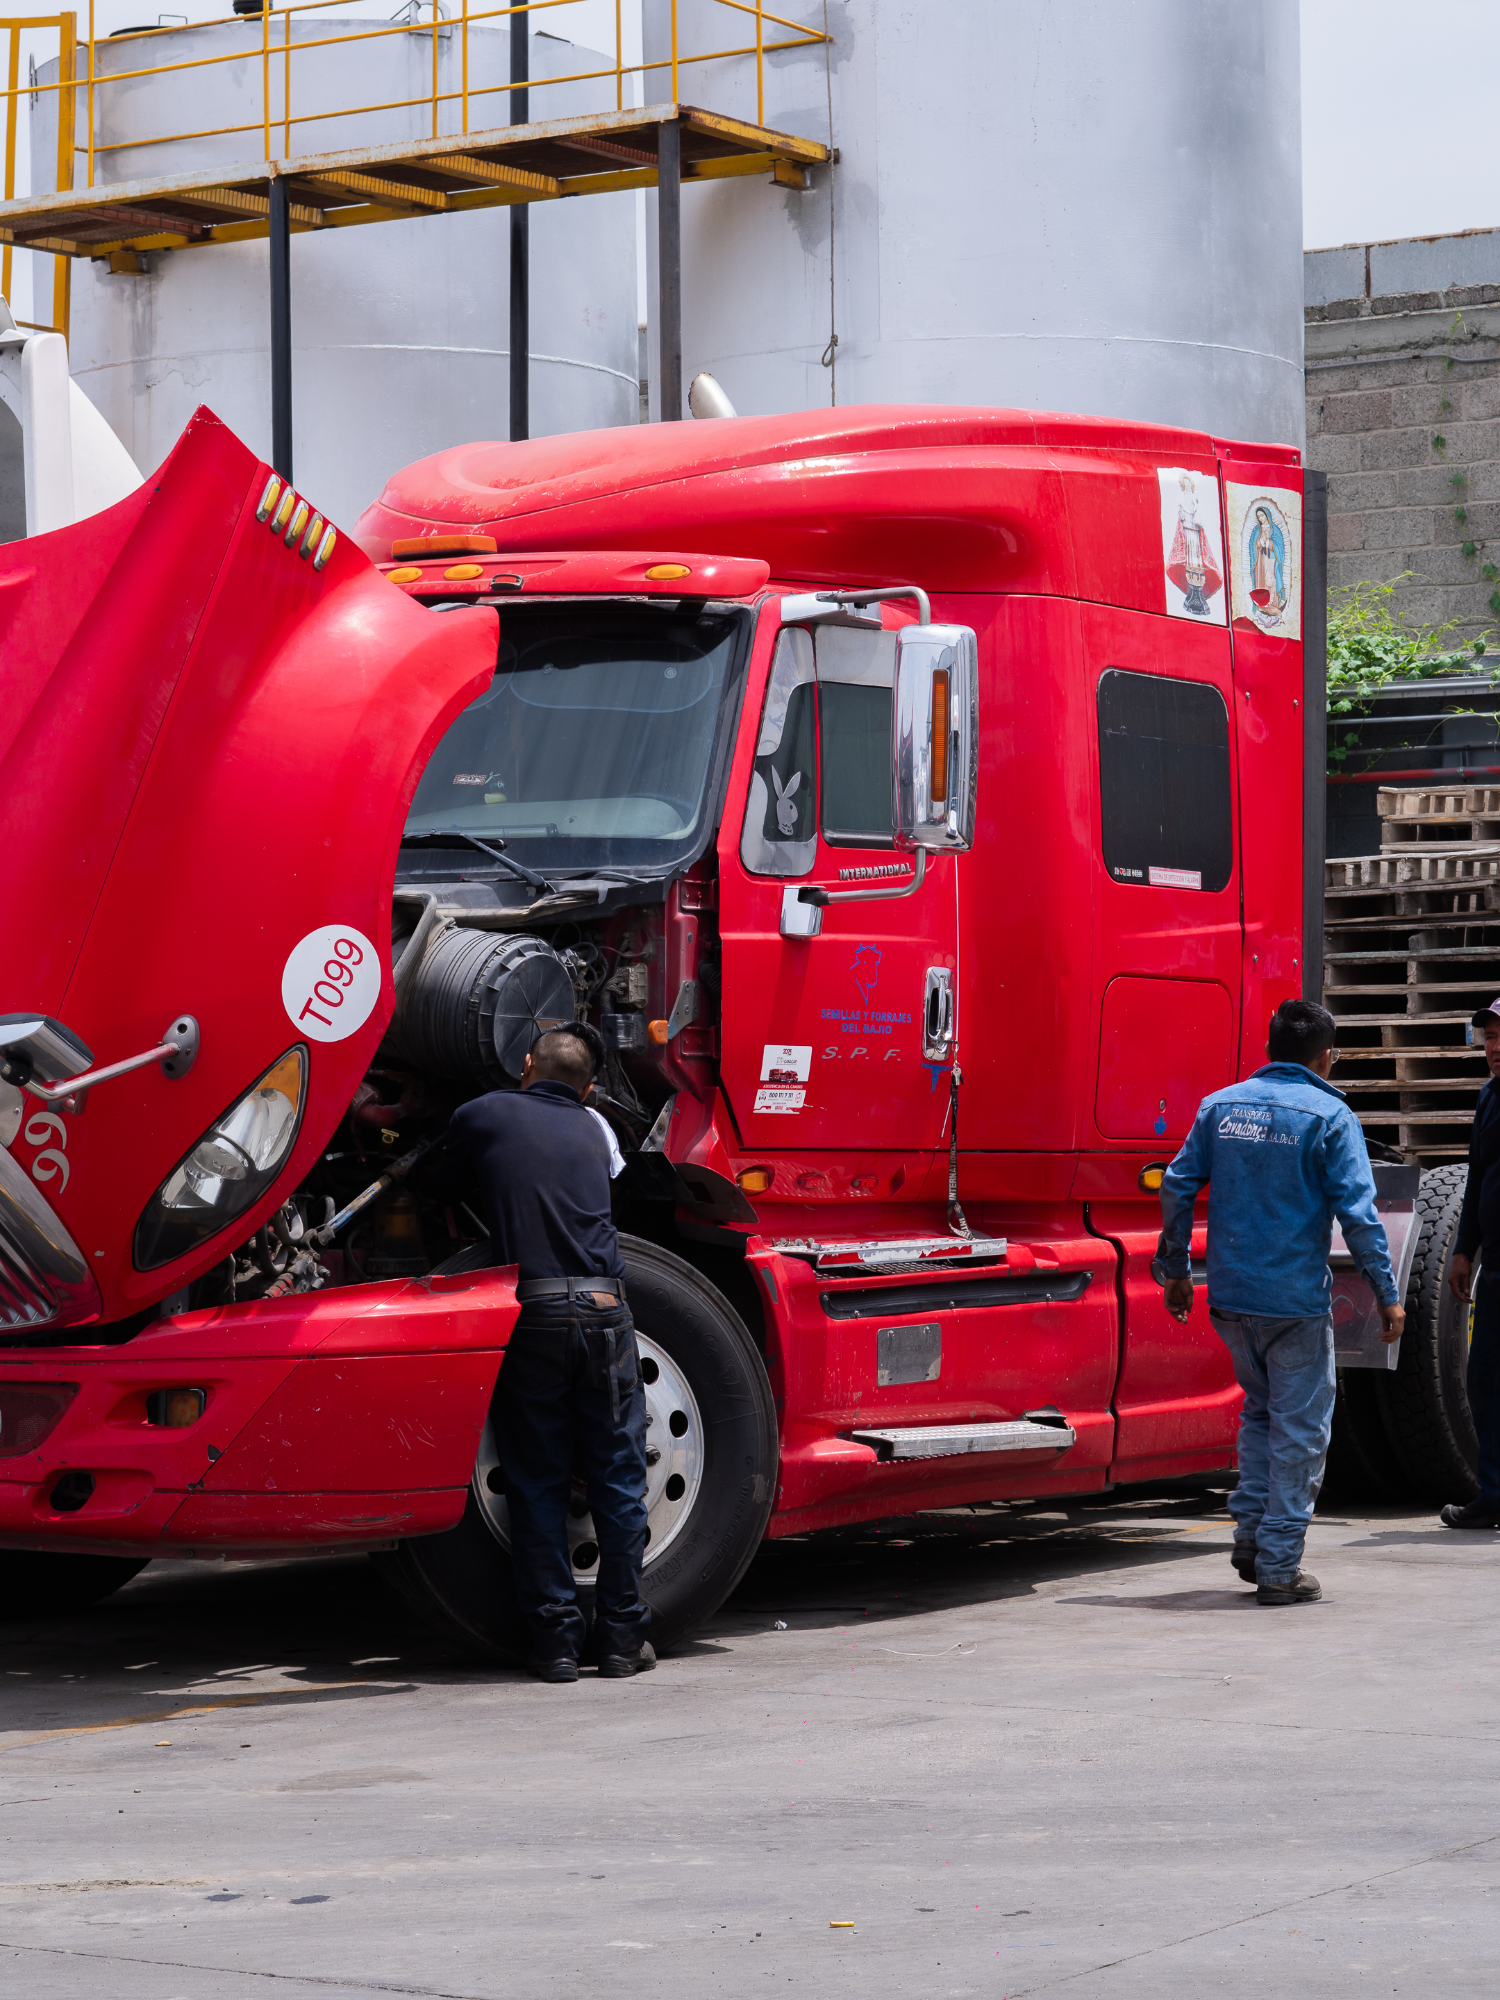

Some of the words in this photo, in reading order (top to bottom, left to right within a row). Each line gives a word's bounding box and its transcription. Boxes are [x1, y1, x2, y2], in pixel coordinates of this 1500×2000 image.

[839, 863, 912, 881] INTERNATIONAL
[298, 937, 364, 1027] T099
[821, 1009, 861, 1021] SEMILLAS
[863, 1011, 869, 1021] Y
[871, 1012, 912, 1024] FORRAJES
[842, 1023, 860, 1033] DEL
[863, 1024, 892, 1035] BAJIO
[1231, 1108, 1272, 1120] TRANSPORTES
[948, 1142, 957, 1201] INTERNATIONAL
